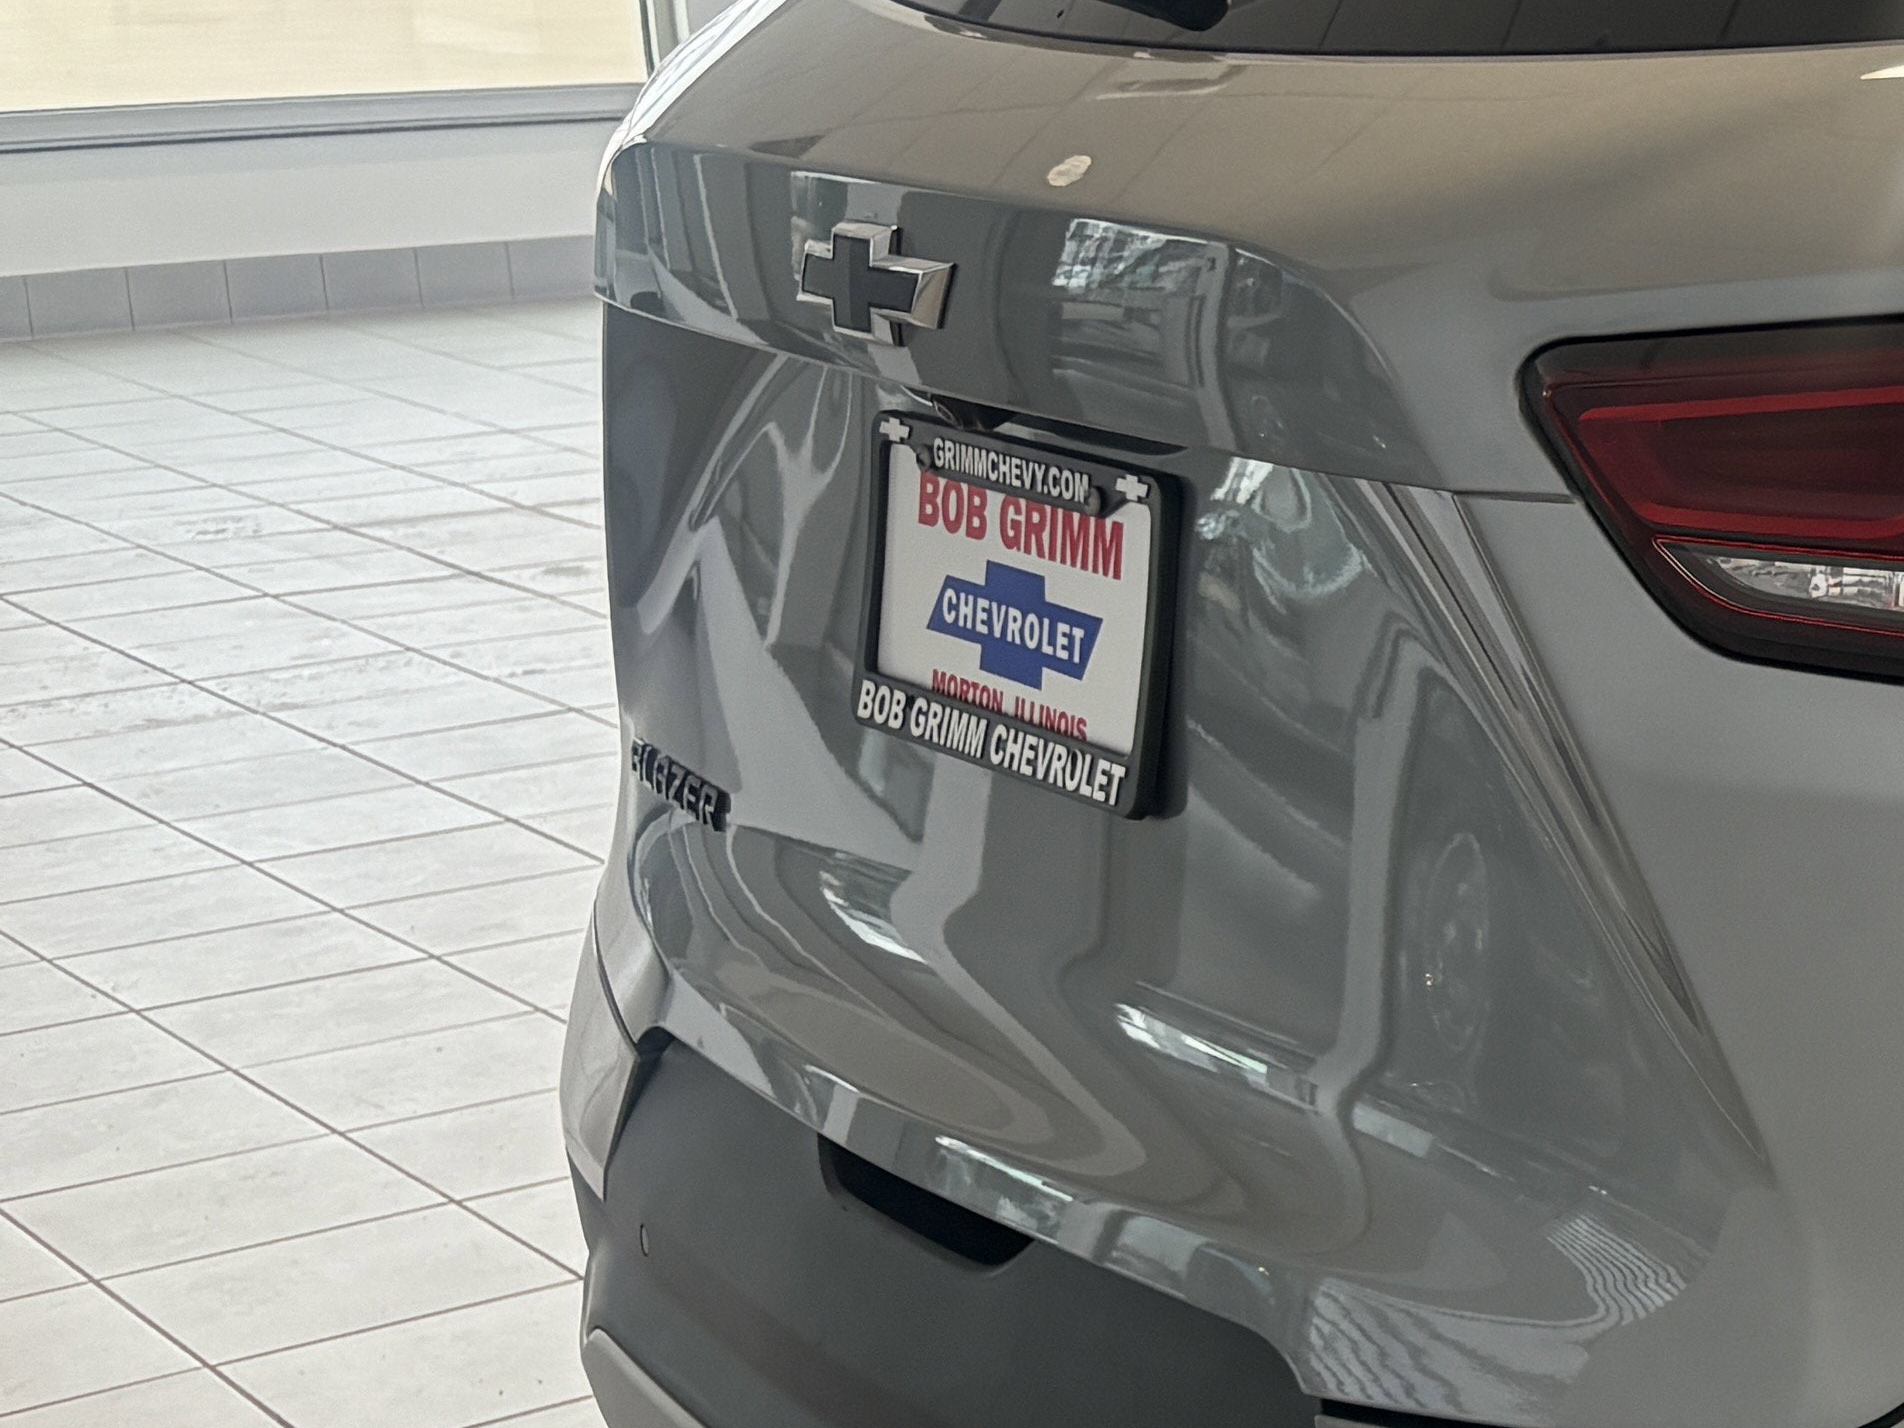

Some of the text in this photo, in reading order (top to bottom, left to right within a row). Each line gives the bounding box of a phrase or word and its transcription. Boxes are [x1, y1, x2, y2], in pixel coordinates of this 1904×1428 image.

[933, 437, 1090, 504] GRIMMCHEVY.COM
[918, 471, 1125, 581] BOB GRIMM
[941, 588, 1085, 664] CHEVROLET
[857, 679, 1126, 806] BOB GRIMM CHEVROLET
